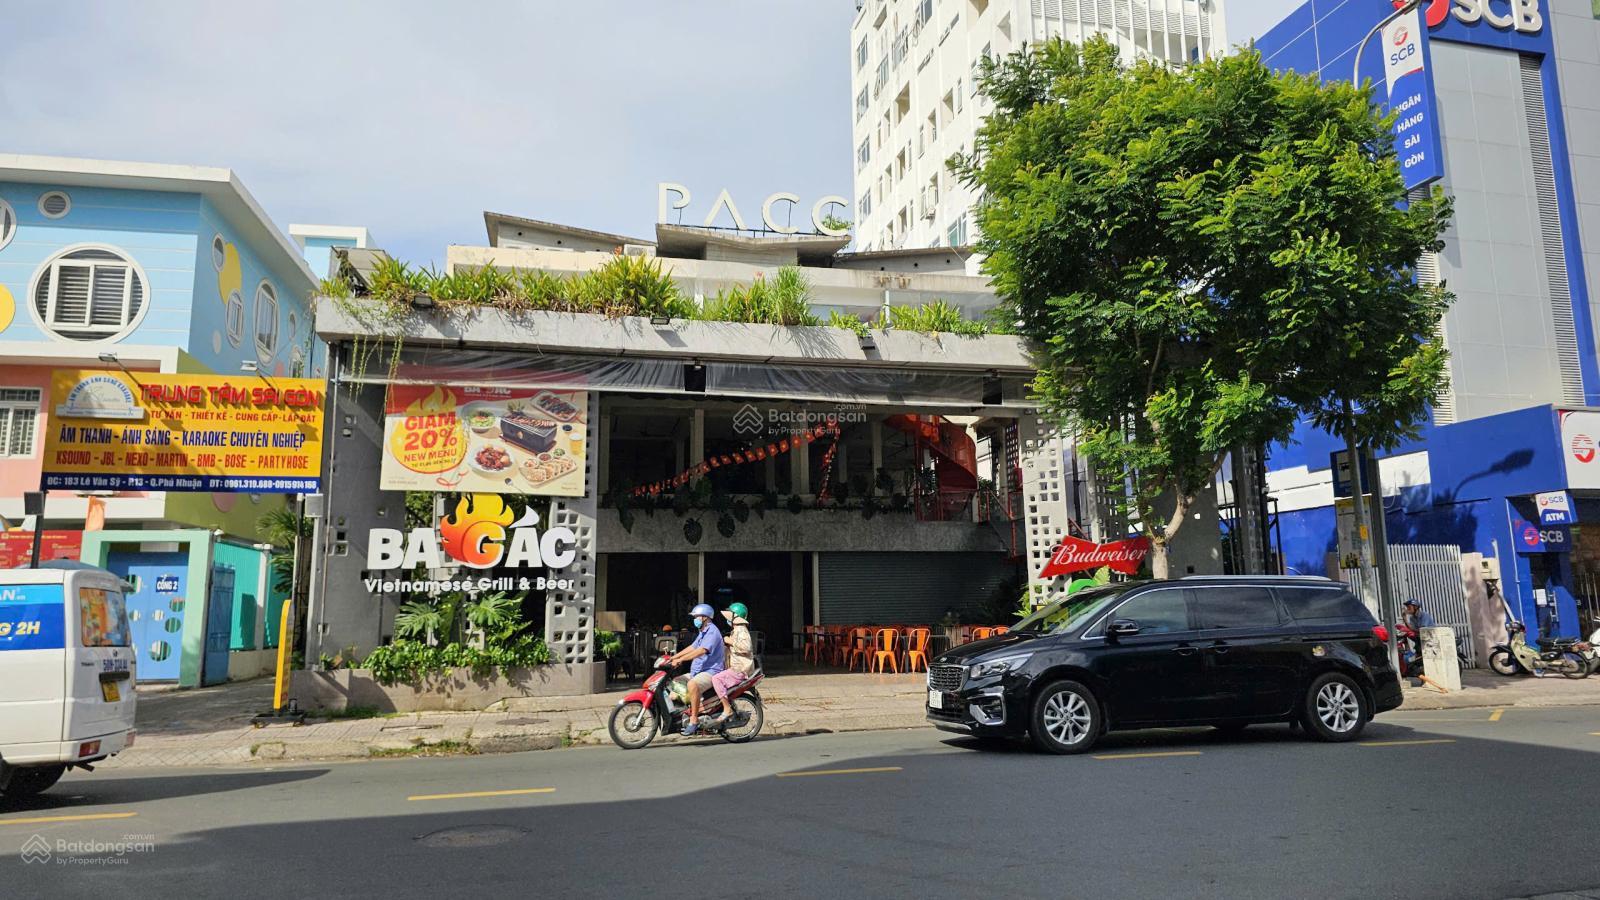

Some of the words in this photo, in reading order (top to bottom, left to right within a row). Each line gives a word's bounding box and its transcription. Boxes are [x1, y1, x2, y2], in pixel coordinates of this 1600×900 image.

[1450, 0, 1543, 33] SCB
[1390, 43, 1415, 66] SCB
[1395, 93, 1421, 114] NGÂN
[1397, 112, 1424, 133] HÀNG
[1404, 133, 1420, 148] SÀI
[1404, 152, 1425, 168] GÒN
[139, 384, 202, 403] TRUNG
[207, 382, 247, 405] TÂM
[236, 412, 259, 421] CUNG
[59, 424, 76, 443] ÂM
[80, 427, 112, 443] THANH
[121, 426, 142, 445] ÁNH
[145, 427, 171, 446] SÁNG
[182, 430, 228, 447] KARAOKE
[230, 430, 269, 448] CHUYÊN
[272, 430, 306, 451] NGHIỆP
[404, 427, 458, 451] 20%
[56, 450, 91, 465] KSOUND
[100, 451, 115, 466] JBL
[125, 452, 148, 466] NEXO
[155, 452, 188, 467] MARTIN
[197, 453, 216, 468] BMB
[224, 454, 247, 468] BOSE
[404, 452, 427, 463] NEW
[428, 448, 457, 460] MENU
[80, 476, 91, 486] Lê
[176, 477, 202, 489] Nhuận
[1548, 496, 1564, 504] SCB
[1545, 512, 1565, 522] ATM
[1539, 530, 1564, 543] SCB
[1050, 543, 1148, 565] Budweiser
[173, 580, 178, 590] 2
[364, 577, 472, 593] Vietnamese
[478, 577, 513, 591] Grill
[519, 577, 531, 590] &
[537, 577, 574, 590] Beer
[16, 621, 41, 635] 2H
